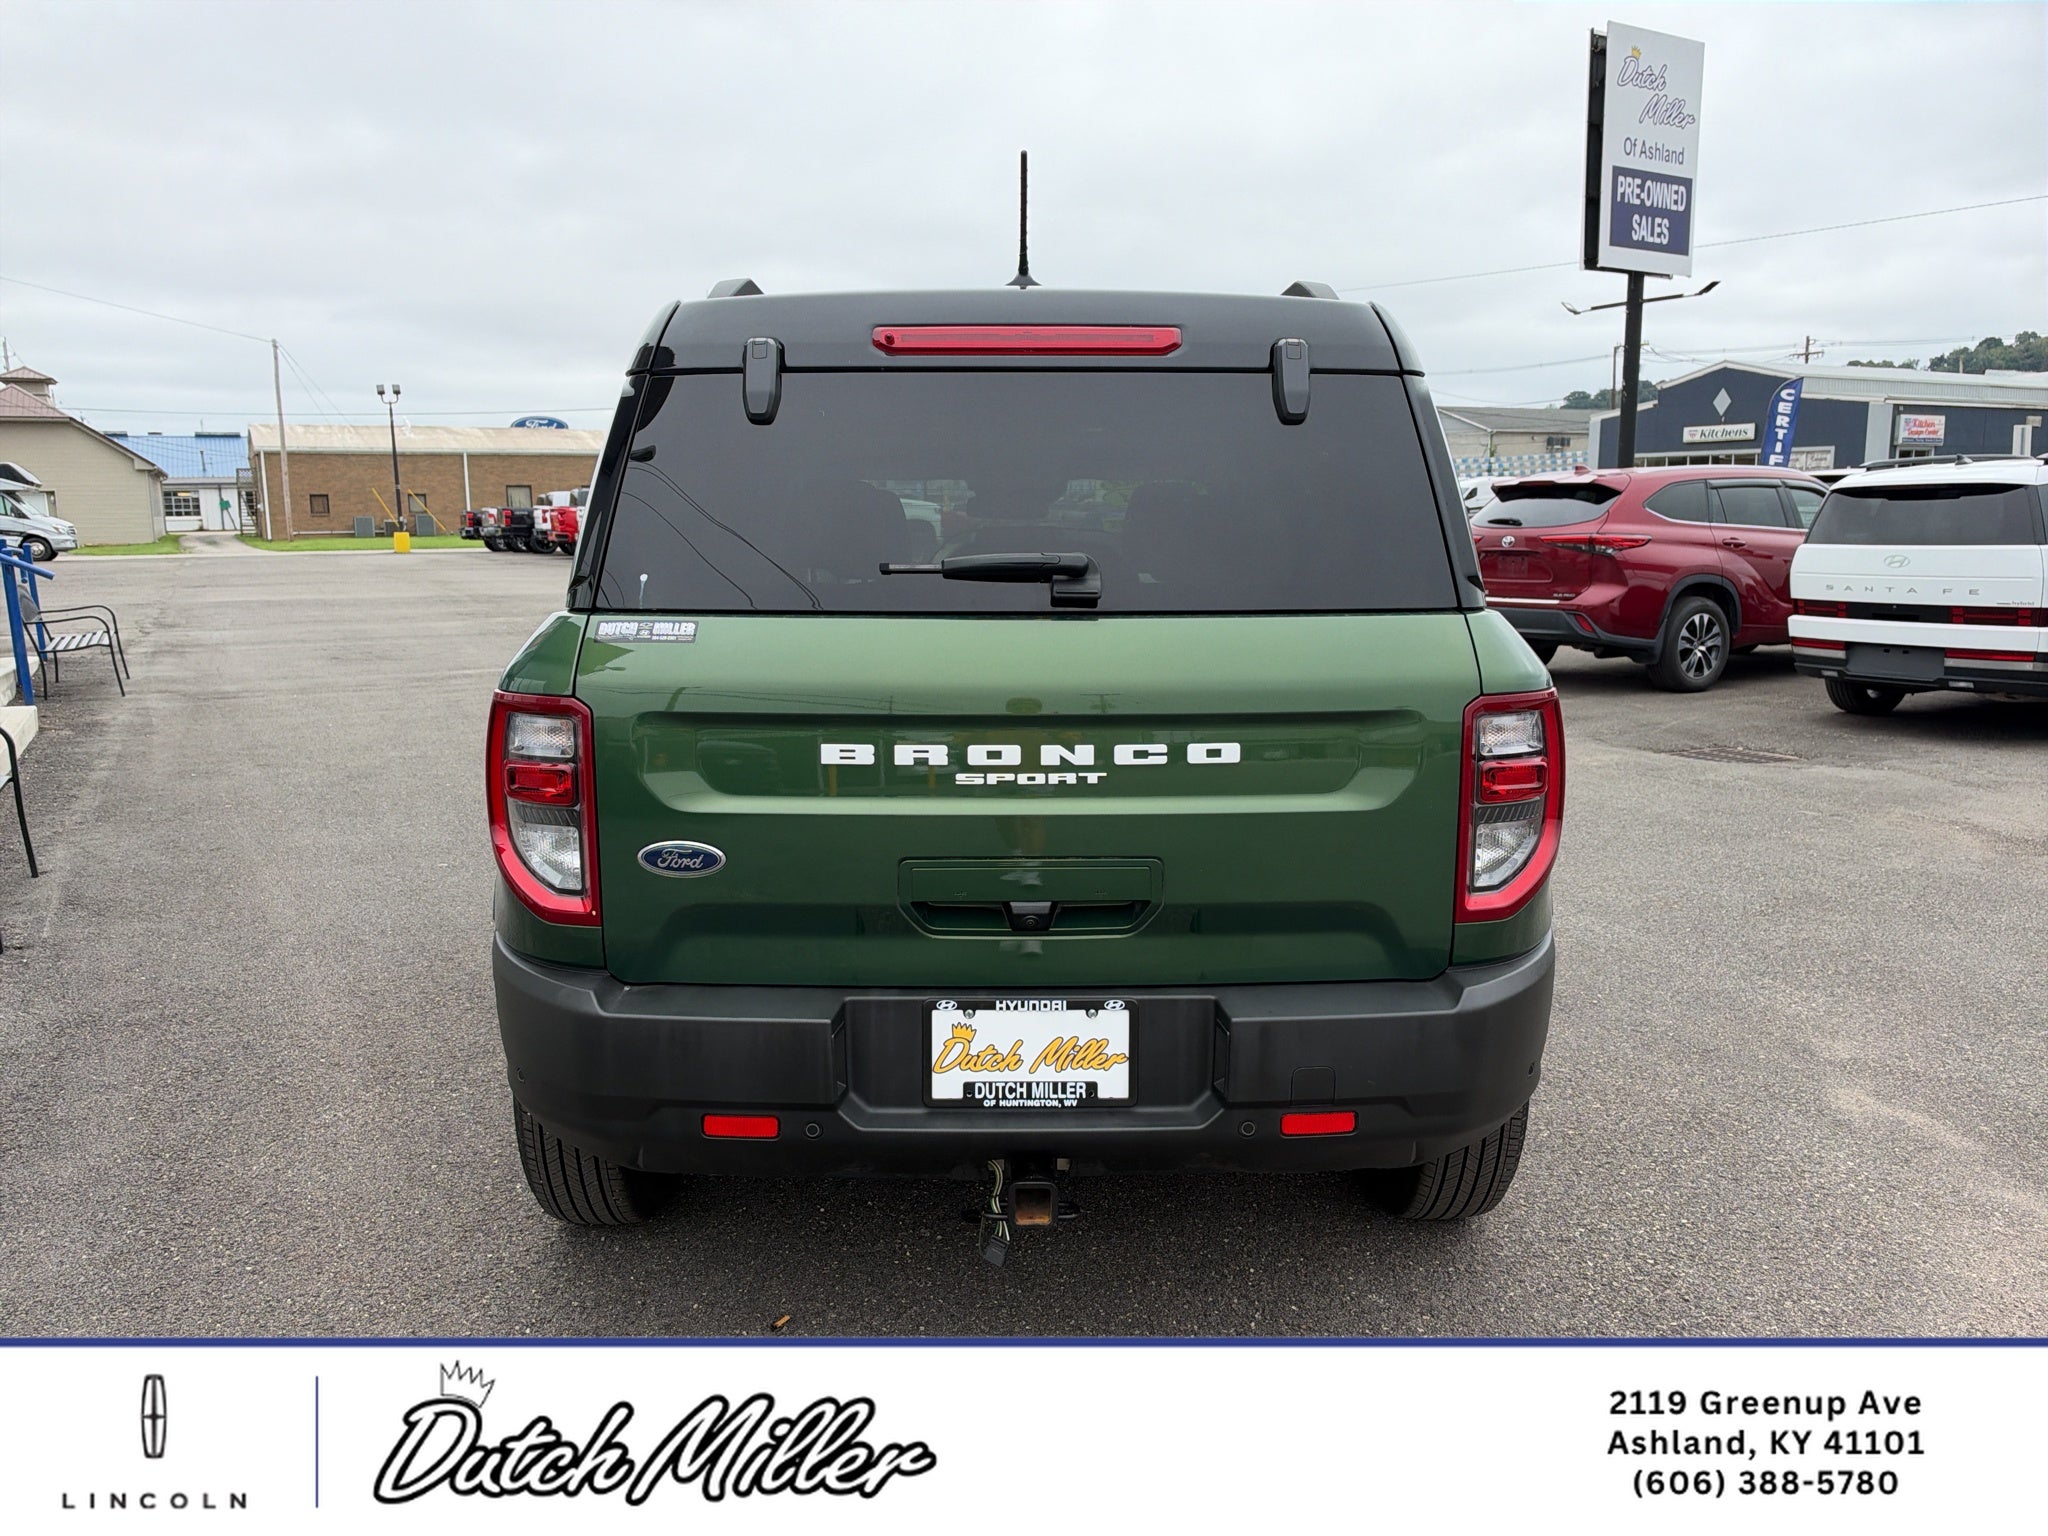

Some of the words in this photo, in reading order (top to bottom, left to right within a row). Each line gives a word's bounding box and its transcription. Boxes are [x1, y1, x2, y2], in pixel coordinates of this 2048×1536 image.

[1617, 56, 1667, 92] Dutch
[1639, 94, 1695, 129] Miller
[1623, 137, 1637, 157] Of
[1639, 142, 1684, 165] Ashland
[1617, 175, 1687, 212] PRE-OWNED
[1631, 214, 1670, 245] SALES
[1700, 428, 1748, 439] Kitchens
[1825, 584, 1918, 594] SANTA
[1942, 588, 1980, 596] FE
[598, 622, 639, 636] DUTCH
[652, 622, 696, 636] MILLER
[820, 742, 1241, 766] BRONCO
[955, 772, 1107, 785] SPORT
[657, 848, 704, 869] Ford
[995, 1000, 1067, 1012] HYUNDAI
[932, 1036, 1024, 1074] Dutch
[1029, 1036, 1129, 1074] Miller
[975, 1082, 1030, 1099] DUTCH
[1031, 1082, 1086, 1099] MILLER
[999, 1100, 1062, 1108] HUNTINGTON,
